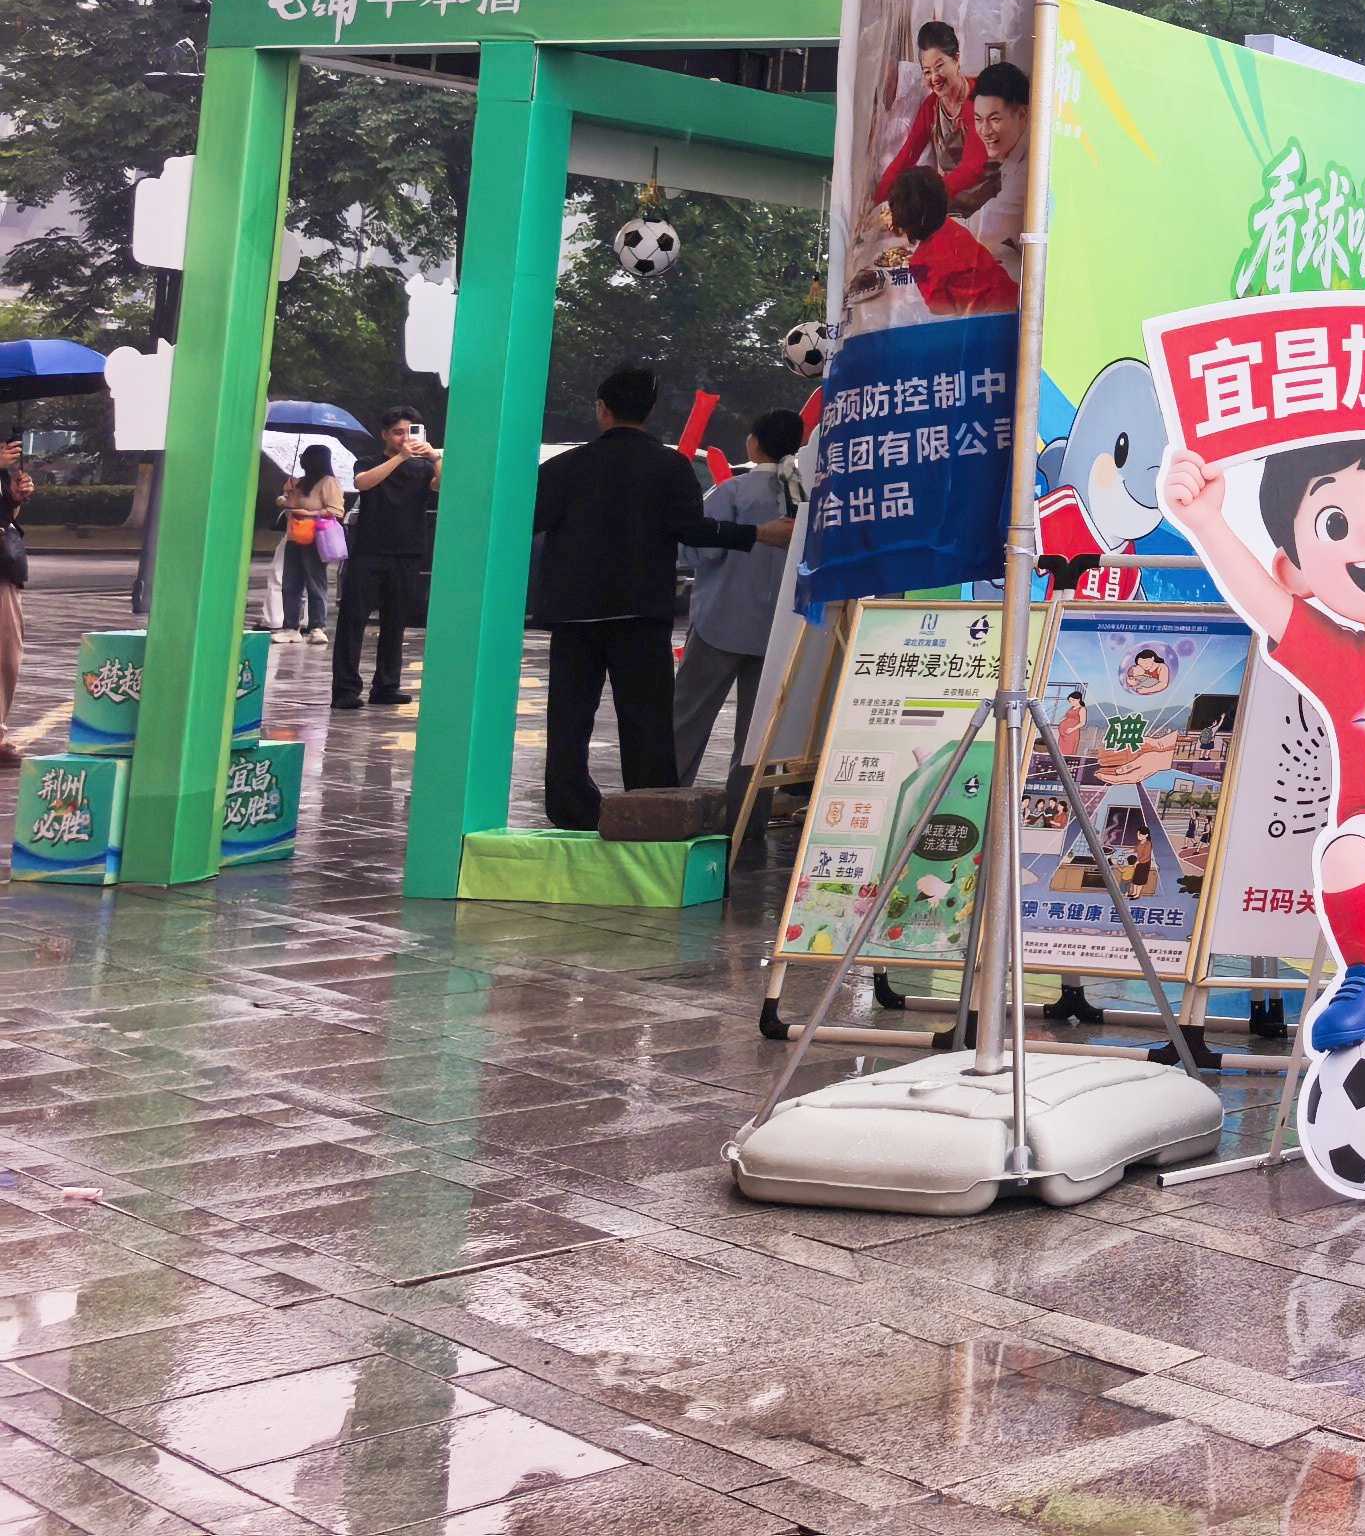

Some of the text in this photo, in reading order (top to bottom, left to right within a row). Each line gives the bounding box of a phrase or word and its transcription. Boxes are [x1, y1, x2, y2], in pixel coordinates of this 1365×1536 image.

[814, 418, 1015, 489] 集团有限公司
[1105, 714, 1148, 752] 碘
